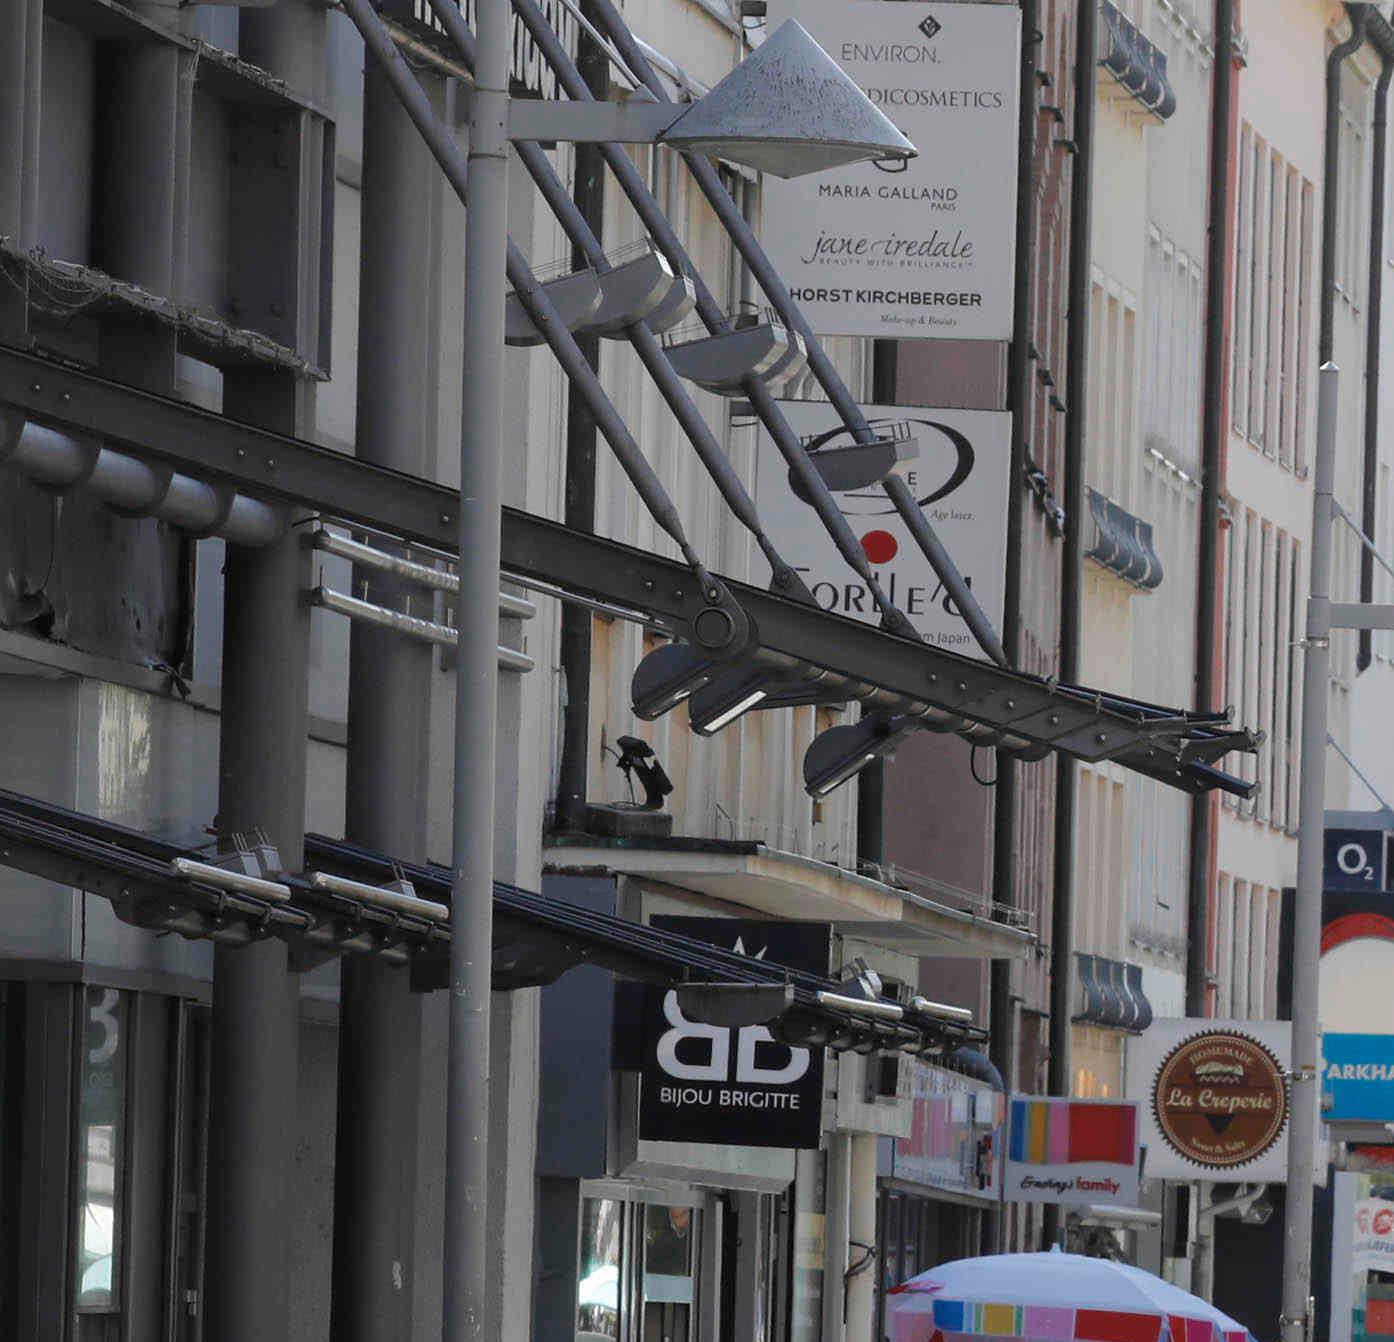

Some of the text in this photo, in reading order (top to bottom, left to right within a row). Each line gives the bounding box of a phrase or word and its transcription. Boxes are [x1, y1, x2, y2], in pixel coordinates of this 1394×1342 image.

[818, 184, 957, 200] MARIA GALLAND
[930, 202, 956, 211] PARIS
[801, 230, 974, 264] jane iredale
[790, 288, 982, 306] HORST KIRCHBERGER
[938, 631, 970, 646] Japan
[661, 1088, 800, 1110] BIJOU BRIGITTE
[1166, 1087, 1194, 1107] La
[1076, 1175, 1120, 1195] family
